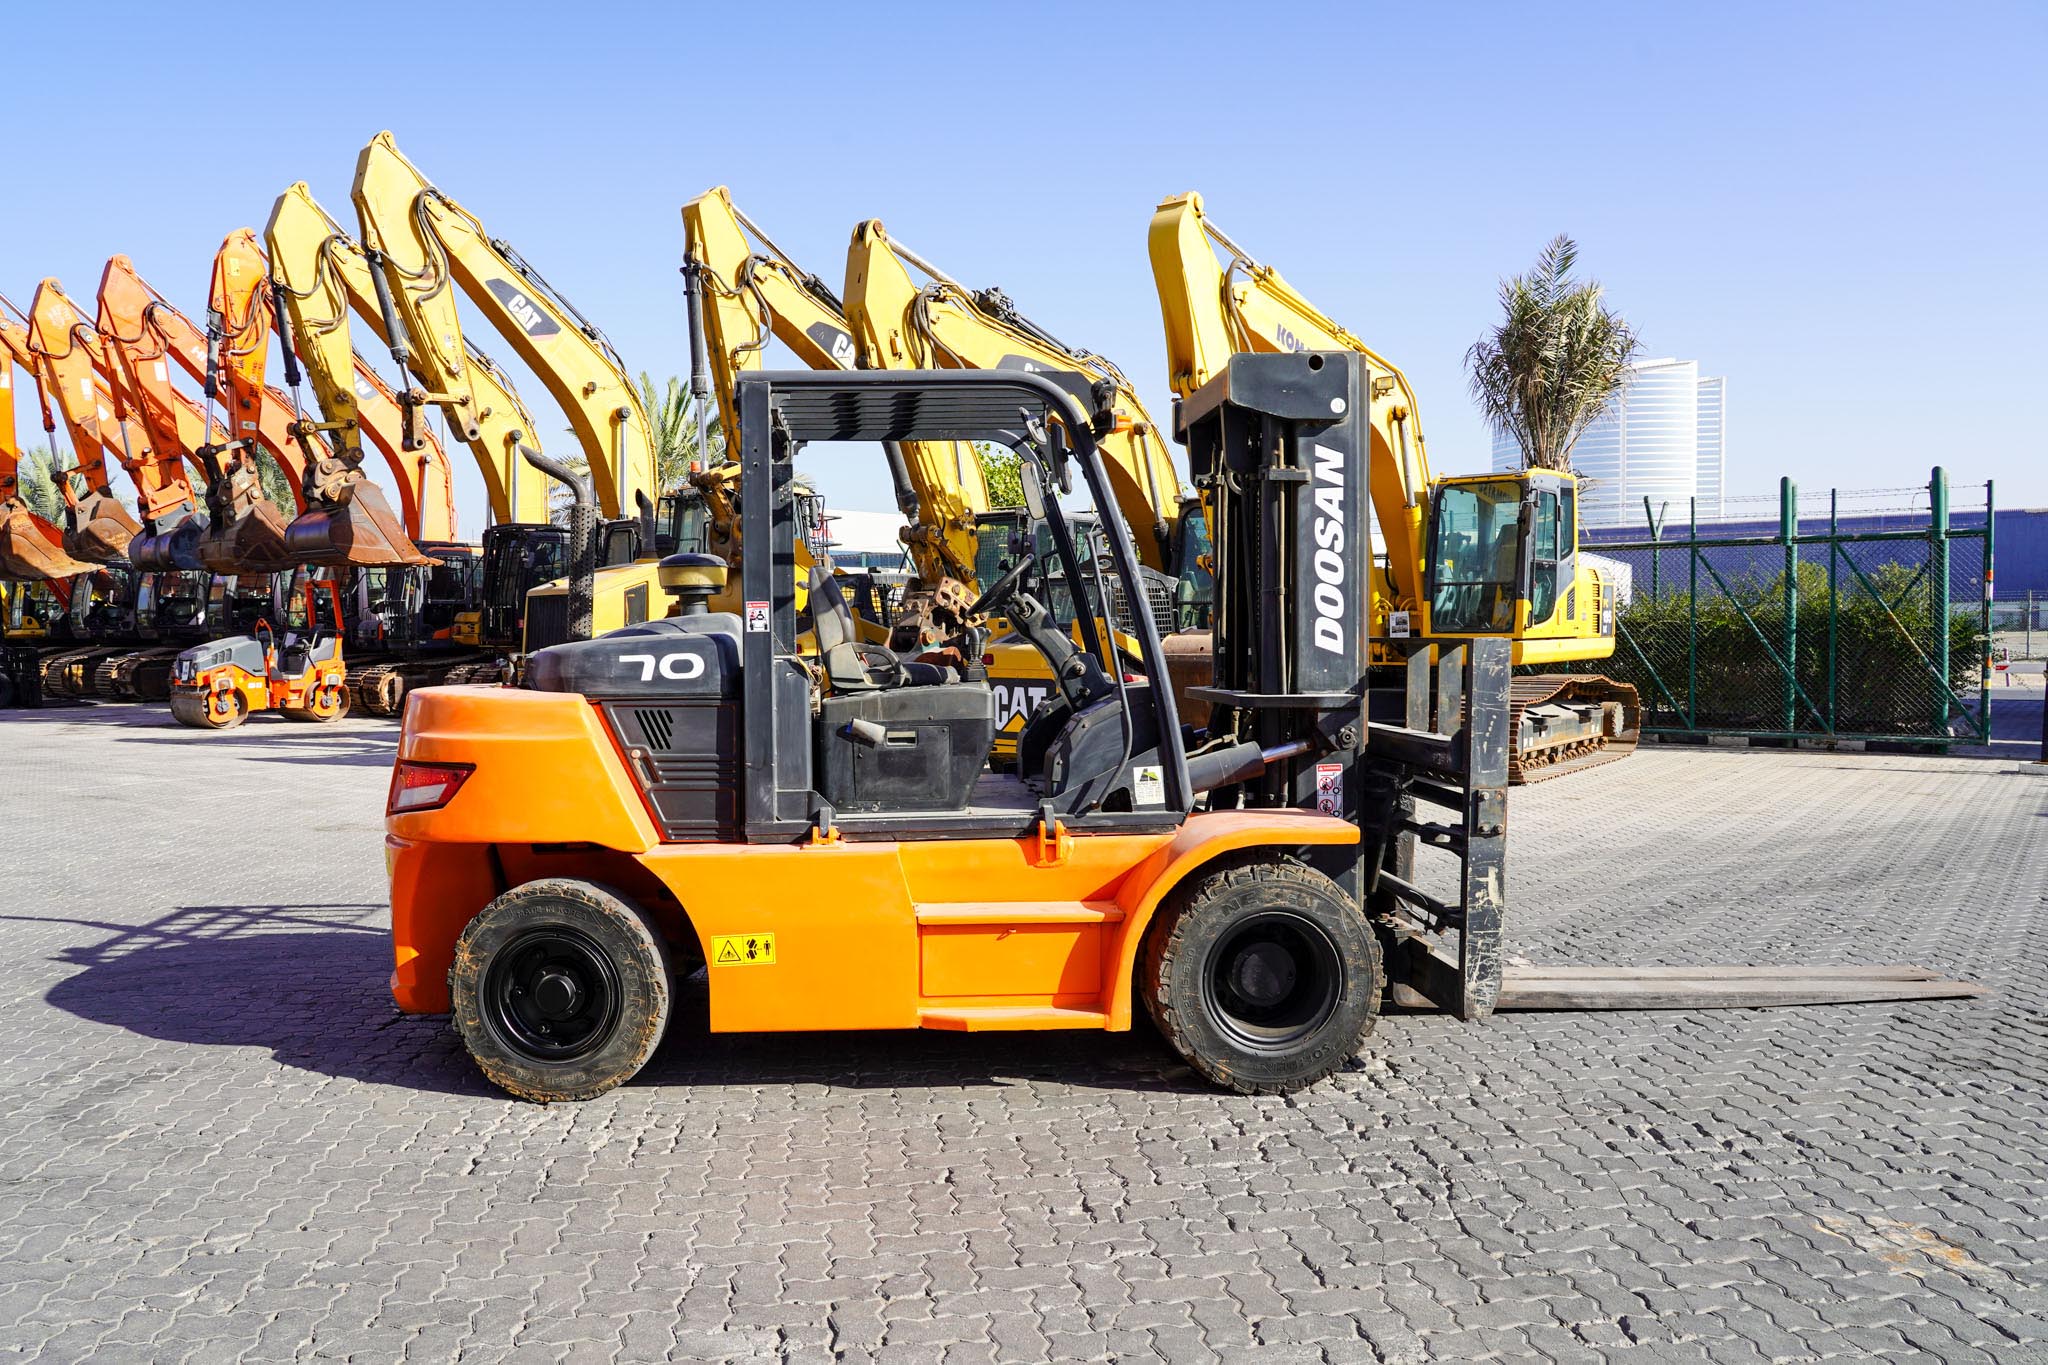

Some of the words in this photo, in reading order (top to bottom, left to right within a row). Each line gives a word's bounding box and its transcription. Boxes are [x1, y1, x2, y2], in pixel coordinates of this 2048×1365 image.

[508, 294, 543, 332] CAT
[832, 333, 858, 371] CA
[1276, 323, 1310, 351] KOM
[1314, 444, 1345, 655] DOOSAN
[618, 652, 706, 681] 70
[993, 685, 1047, 731] CAT
